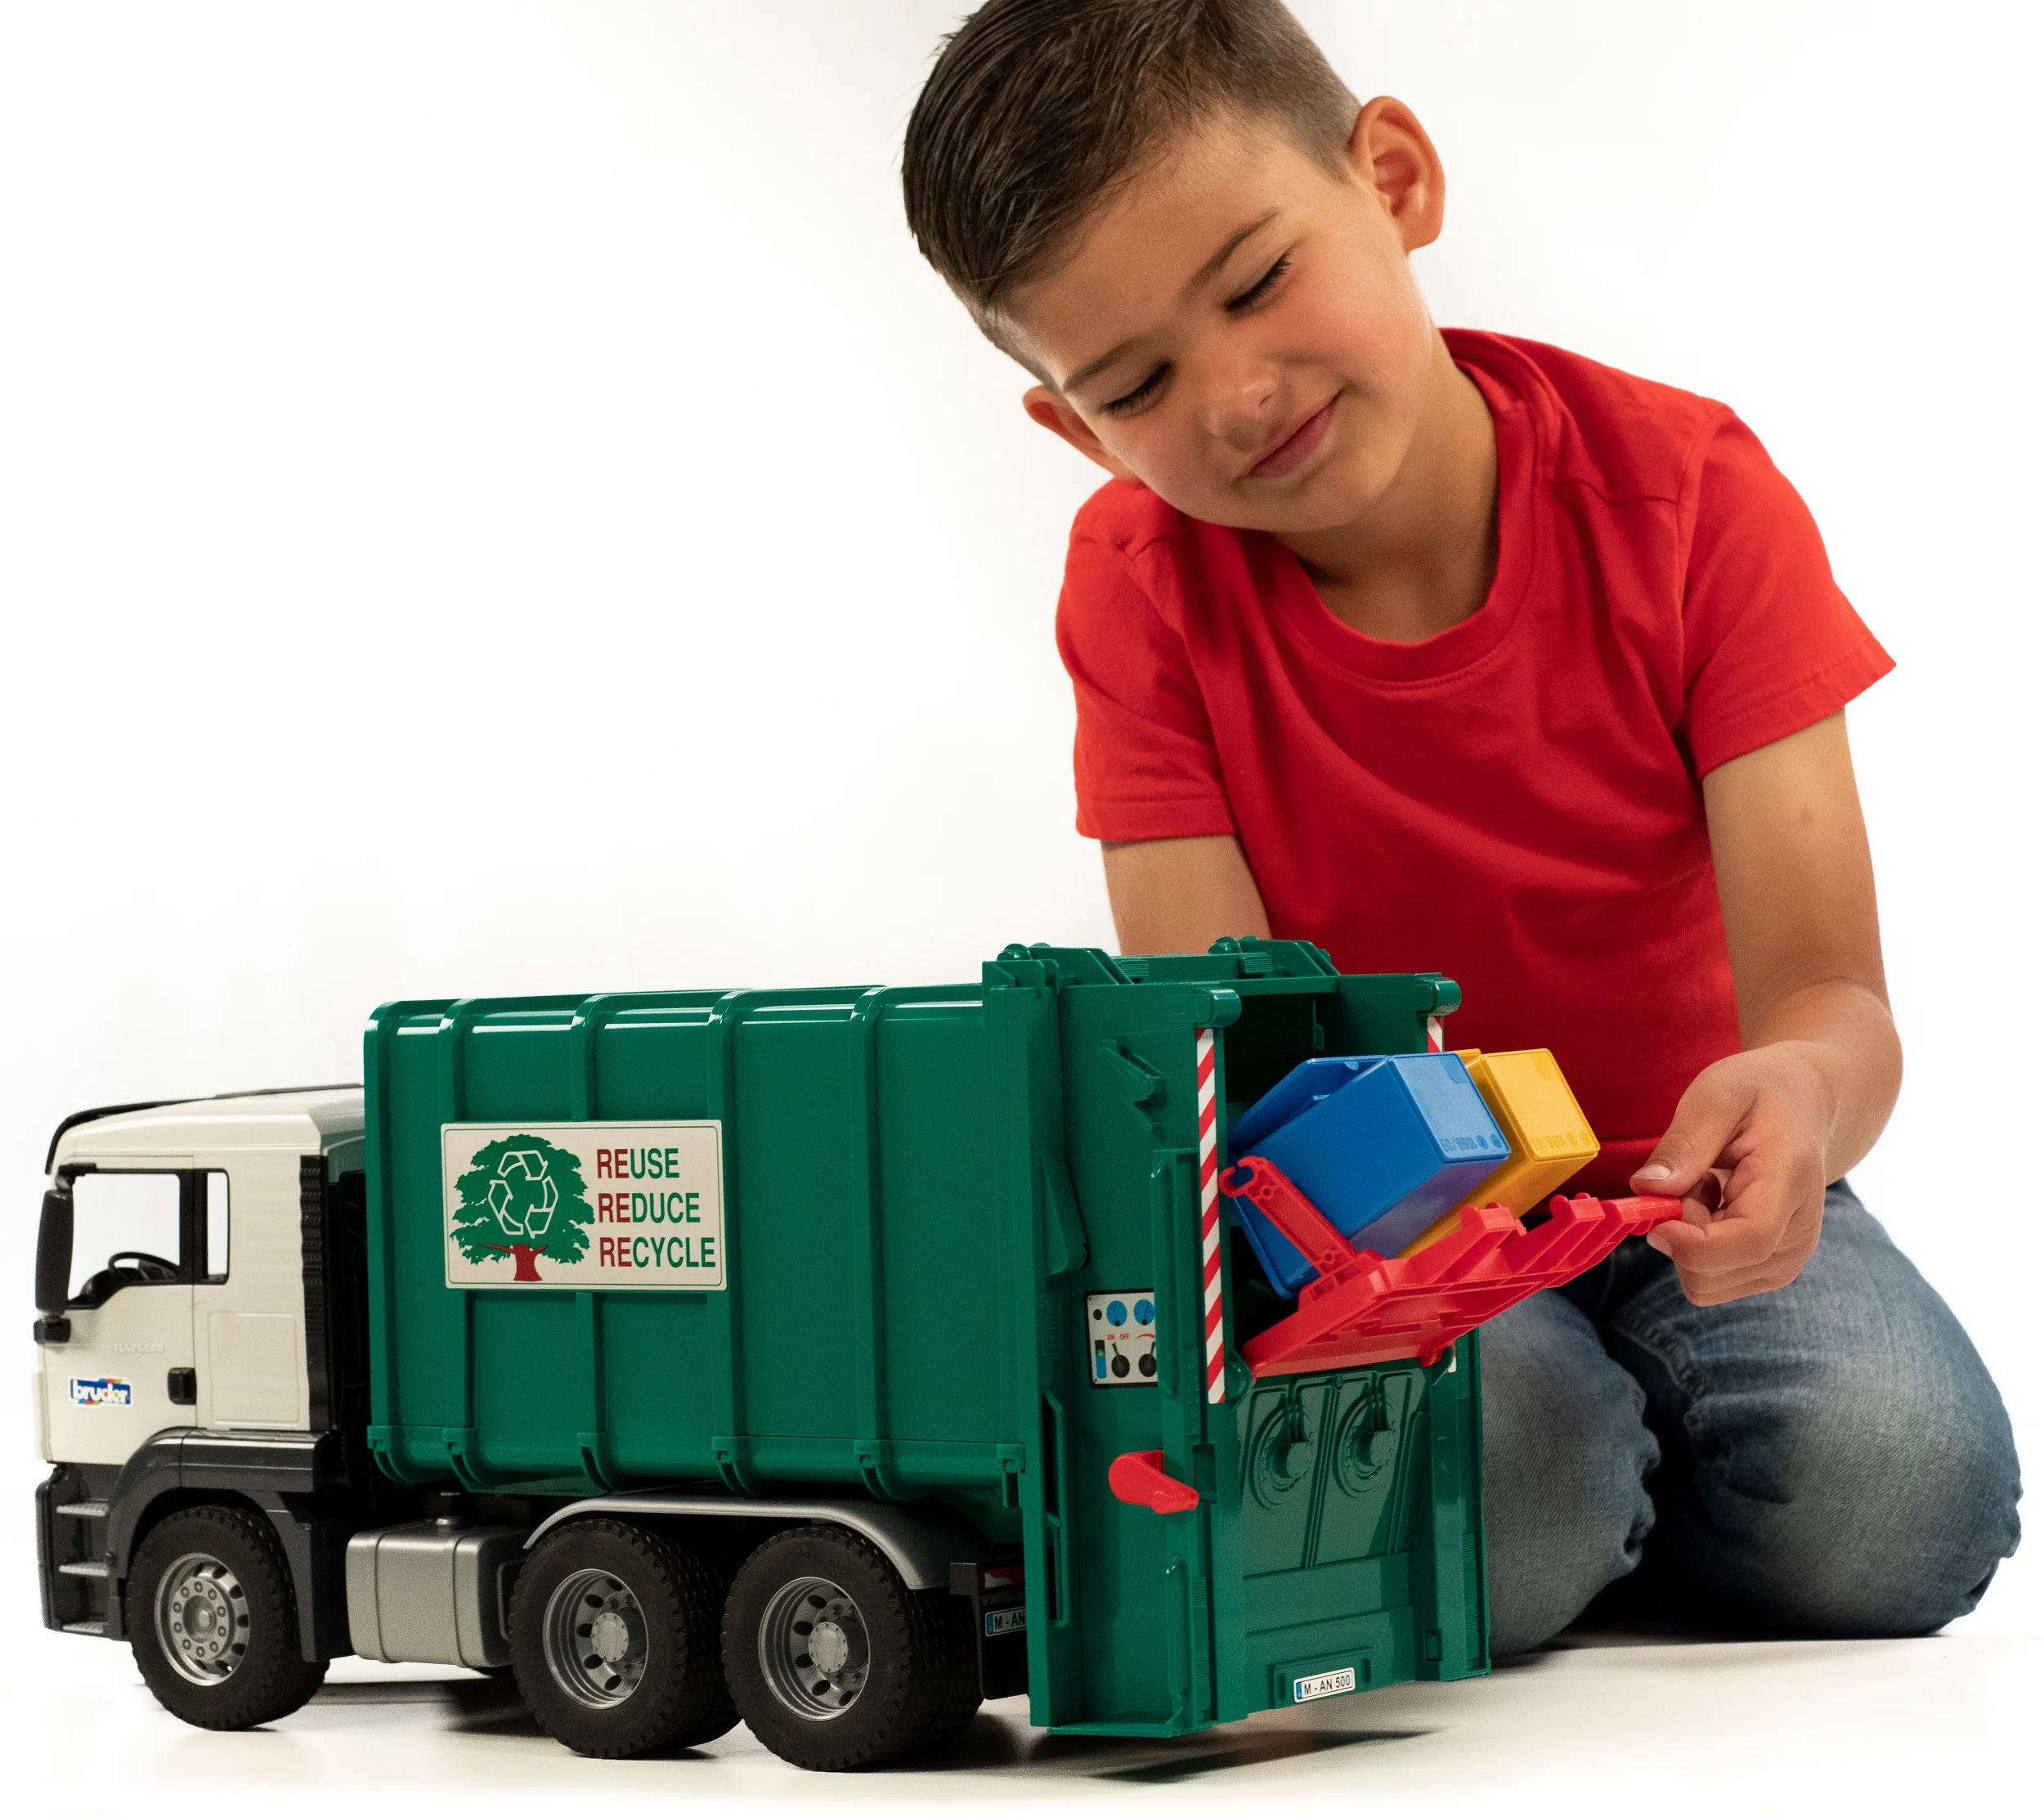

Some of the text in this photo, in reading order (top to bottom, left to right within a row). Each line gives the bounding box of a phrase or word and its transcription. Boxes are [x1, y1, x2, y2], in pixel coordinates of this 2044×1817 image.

[597, 1148, 679, 1178] REUSE
[598, 1191, 701, 1224] REDUCE
[599, 1236, 716, 1268] RECYCLE
[73, 1380, 128, 1404] bruder
[994, 1615, 1003, 1631] M
[1304, 1683, 1311, 1696] M
[1320, 1678, 1333, 1693] AN
[1335, 1675, 1351, 1688] 500
